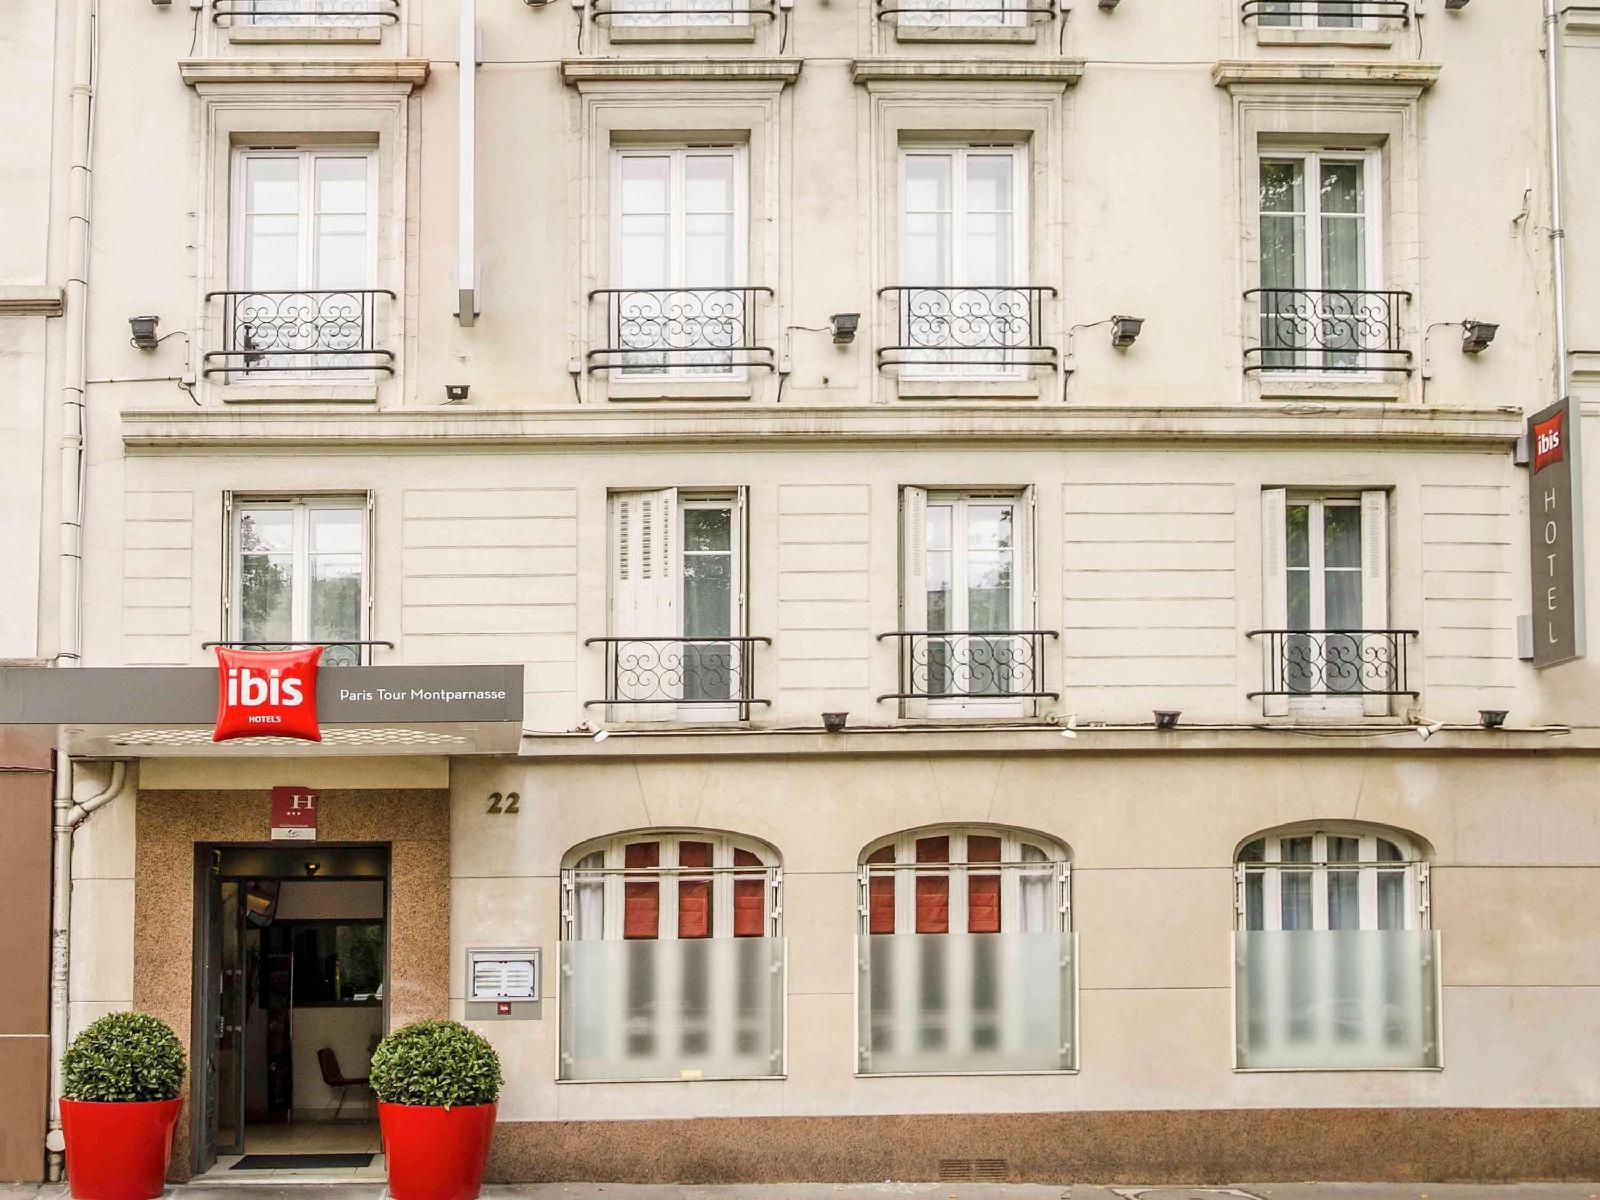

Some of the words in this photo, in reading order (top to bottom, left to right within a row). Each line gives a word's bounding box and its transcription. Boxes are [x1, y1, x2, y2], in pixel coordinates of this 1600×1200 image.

[1538, 430, 1560, 456] ibis
[1544, 488, 1558, 643] HOTEL
[227, 668, 304, 707] ibis
[340, 689, 373, 701] Paris
[377, 688, 407, 701] Tour
[410, 689, 506, 702] Montparnasse
[248, 715, 282, 723] HOTELS
[291, 794, 315, 810] H
[487, 792, 520, 814] 22
